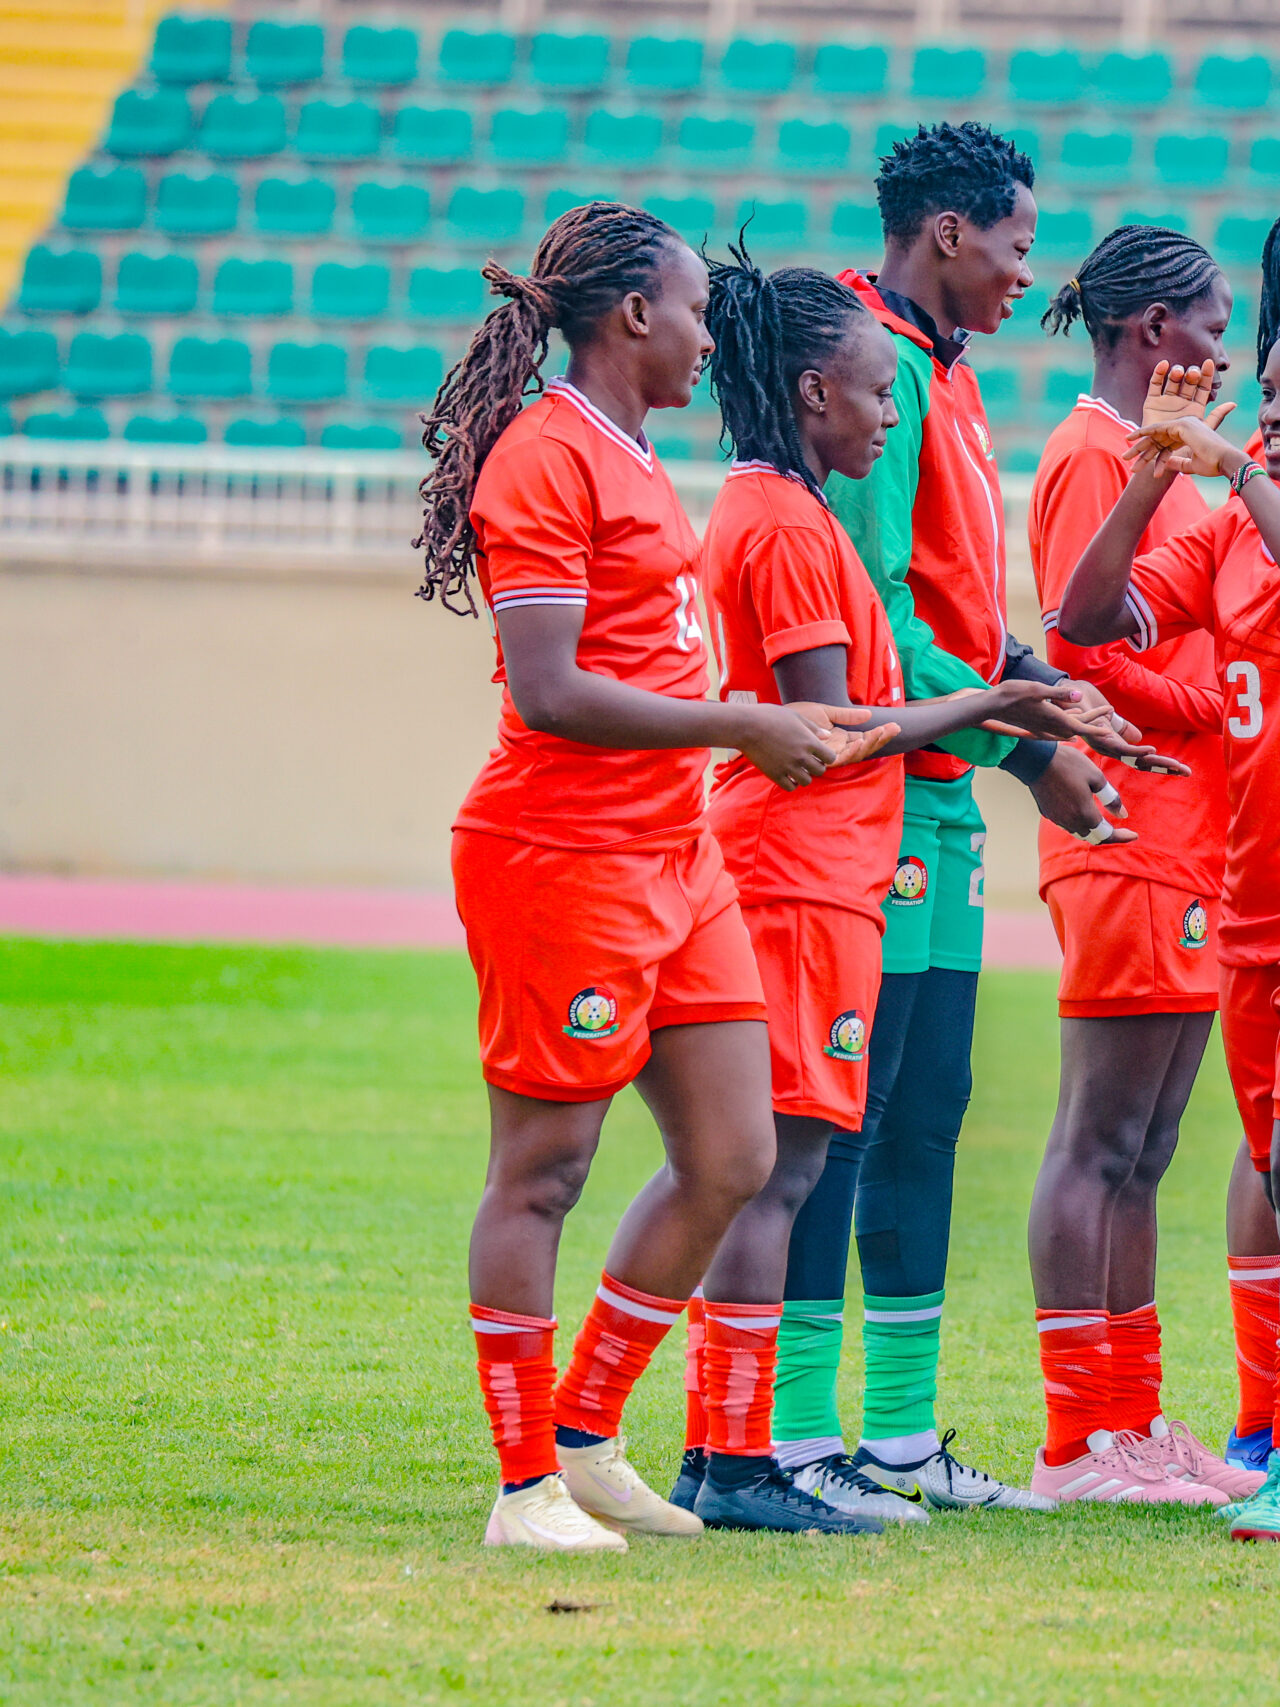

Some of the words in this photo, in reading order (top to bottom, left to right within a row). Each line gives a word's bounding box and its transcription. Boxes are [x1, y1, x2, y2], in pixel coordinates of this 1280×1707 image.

[1226, 660, 1264, 739] 3
[569, 994, 585, 1027] FOOTBALL
[573, 1030, 611, 1040] FEDERATION
[830, 1015, 847, 1048] FOOTBALL
